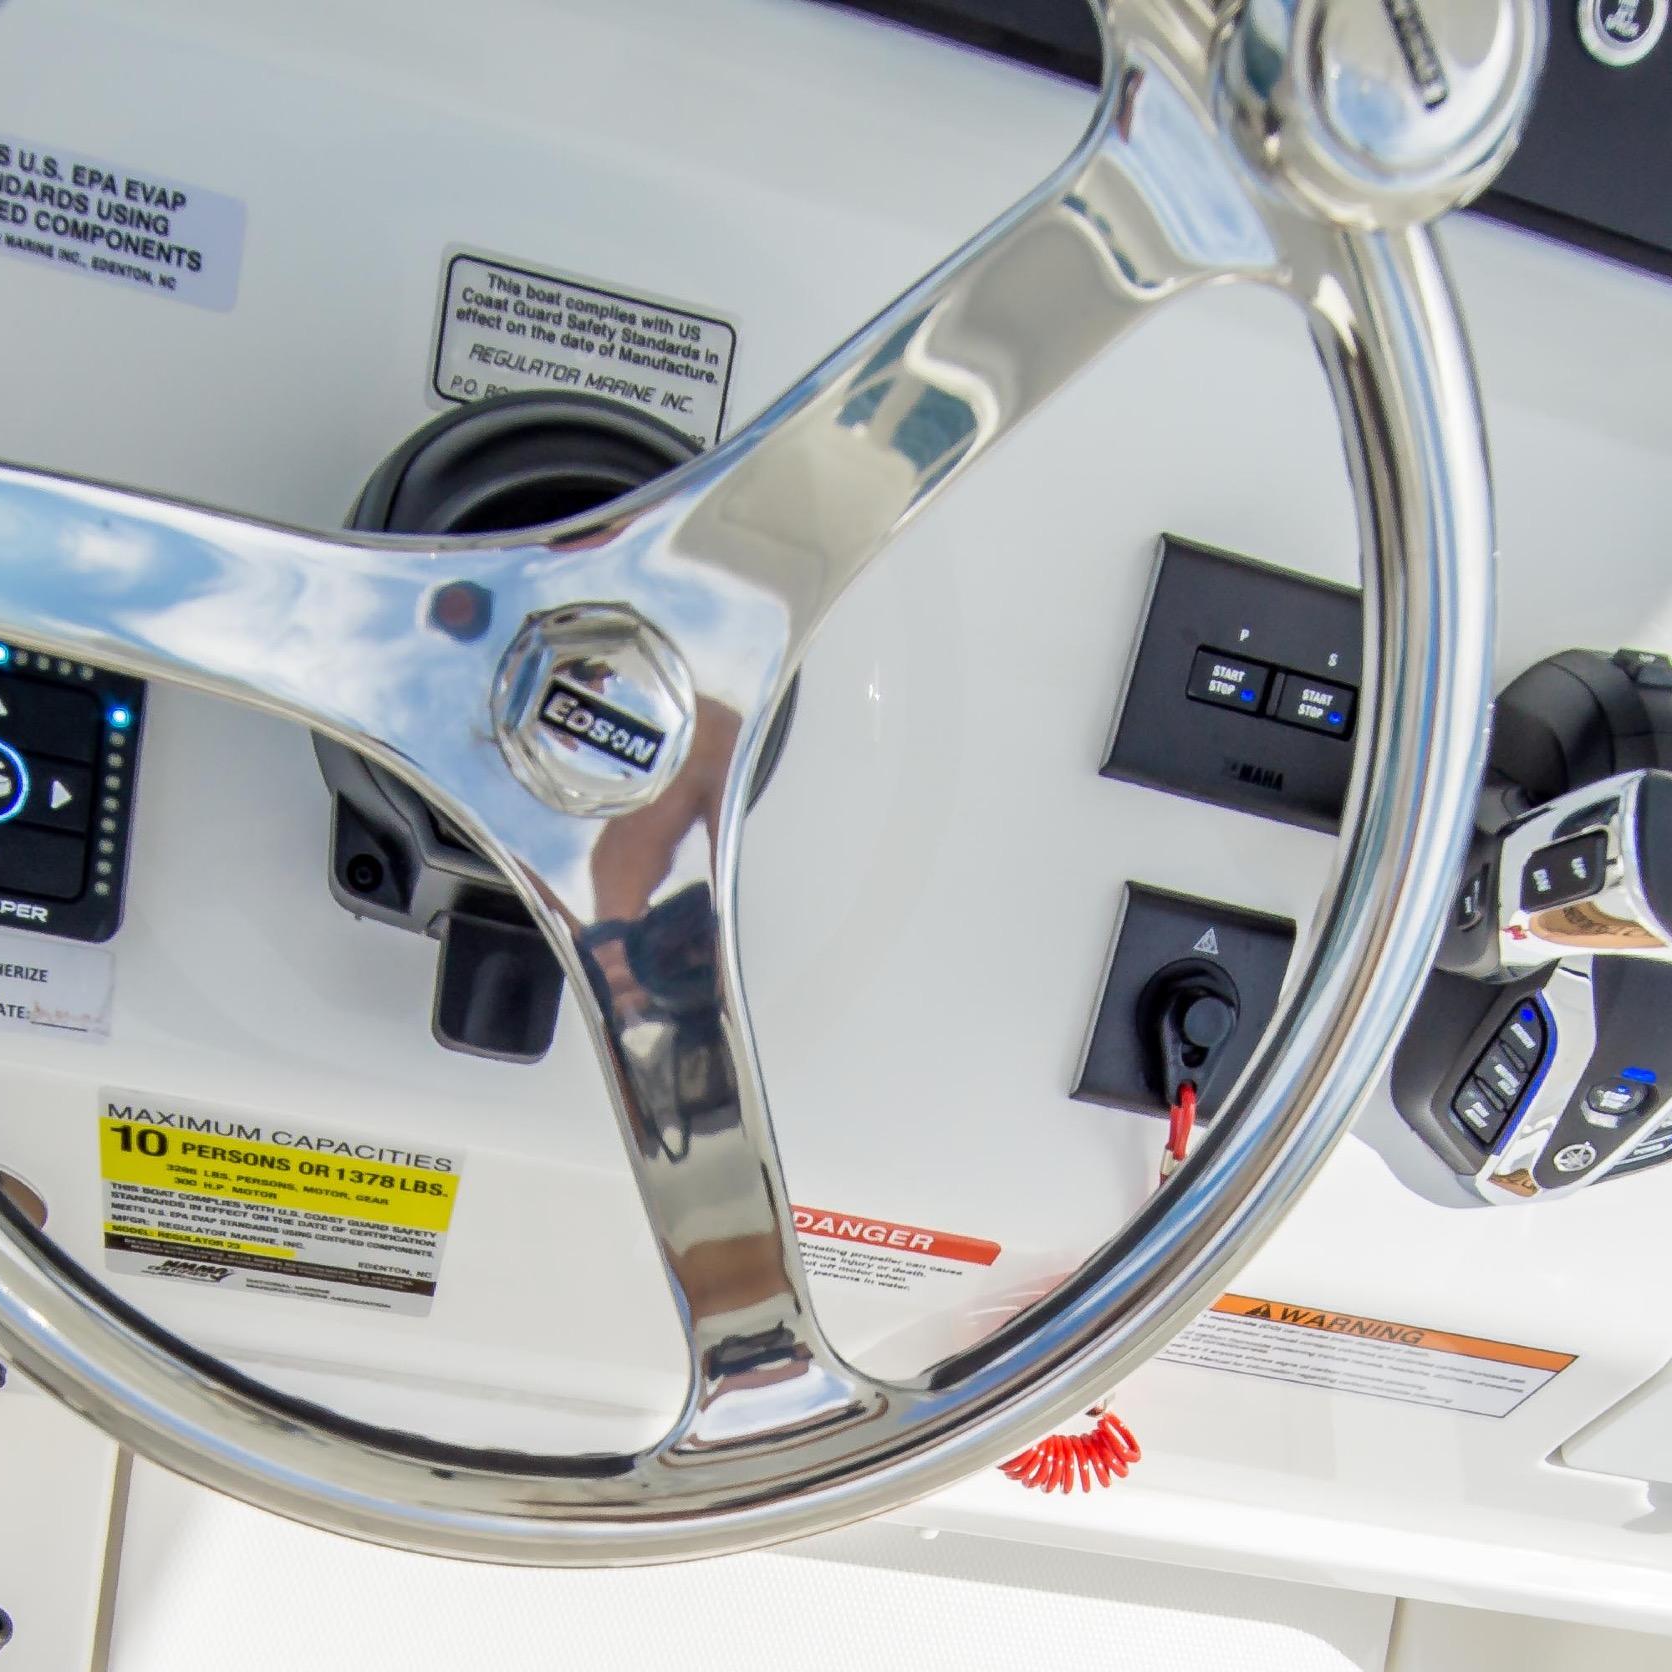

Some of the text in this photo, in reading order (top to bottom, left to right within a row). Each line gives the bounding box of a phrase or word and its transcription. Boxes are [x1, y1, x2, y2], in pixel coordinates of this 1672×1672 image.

[18, 149, 63, 181] U.S.
[72, 164, 117, 196] EPA
[125, 178, 187, 212] EVAP
[96, 200, 170, 237] USING
[34, 209, 203, 273] COMPONENTS
[4, 233, 55, 260] MARINE
[158, 274, 177, 291] NC
[488, 272, 702, 342] This boat complies with US
[456, 306, 719, 385] effect on the date of Manufacture.
[462, 287, 720, 366] Coast Guard Safety Standards in
[469, 343, 694, 414] REGULATOR MARINE INC.
[1239, 628, 1250, 642] P
[1212, 665, 1246, 683] START
[1327, 652, 1339, 668] S
[1208, 679, 1235, 696] STOP
[1301, 689, 1334, 707] START
[543, 691, 657, 764] EDSON
[1297, 703, 1324, 719] STOP
[1223, 759, 1284, 791] MAHA
[108, 1103, 452, 1172] MAXIMUM CAPACITIES
[110, 1125, 449, 1199] 10 PERSONS OR 1378 LBS.
[111, 1182, 139, 1192] THIS
[142, 1187, 175, 1198] BOAT
[178, 1193, 241, 1208] COMPLIES
[244, 1203, 275, 1214] WITH
[304, 1212, 343, 1225] COAST
[347, 1218, 389, 1231] GUARD
[392, 1226, 437, 1238] SAFETY
[231, 1186, 278, 1199] MOTOR
[355, 1195, 389, 1205] GEAR
[111, 1191, 186, 1209] STANDARDS
[189, 1203, 202, 1211] IN
[204, 1205, 248, 1218] EFFECT
[252, 1213, 269, 1222] ON
[273, 1216, 295, 1227] THE
[297, 1220, 328, 1231] DATE
[331, 1225, 345, 1233] OF
[111, 1202, 145, 1214] MEETS
[169, 1211, 189, 1220] EPA
[191, 1214, 216, 1224] EVAP
[220, 1219, 279, 1233] STANDARDS
[282, 1228, 312, 1240] USING
[315, 1233, 365, 1247] CERTIFIED
[158, 1221, 227, 1238] REGULATOR
[793, 1210, 935, 1252] DANGER
[158, 1231, 225, 1247] REGULATOR
[800, 1251, 836, 1262] erious
[416, 1270, 432, 1279] NC
[1278, 1307, 1426, 1345] WARNING
